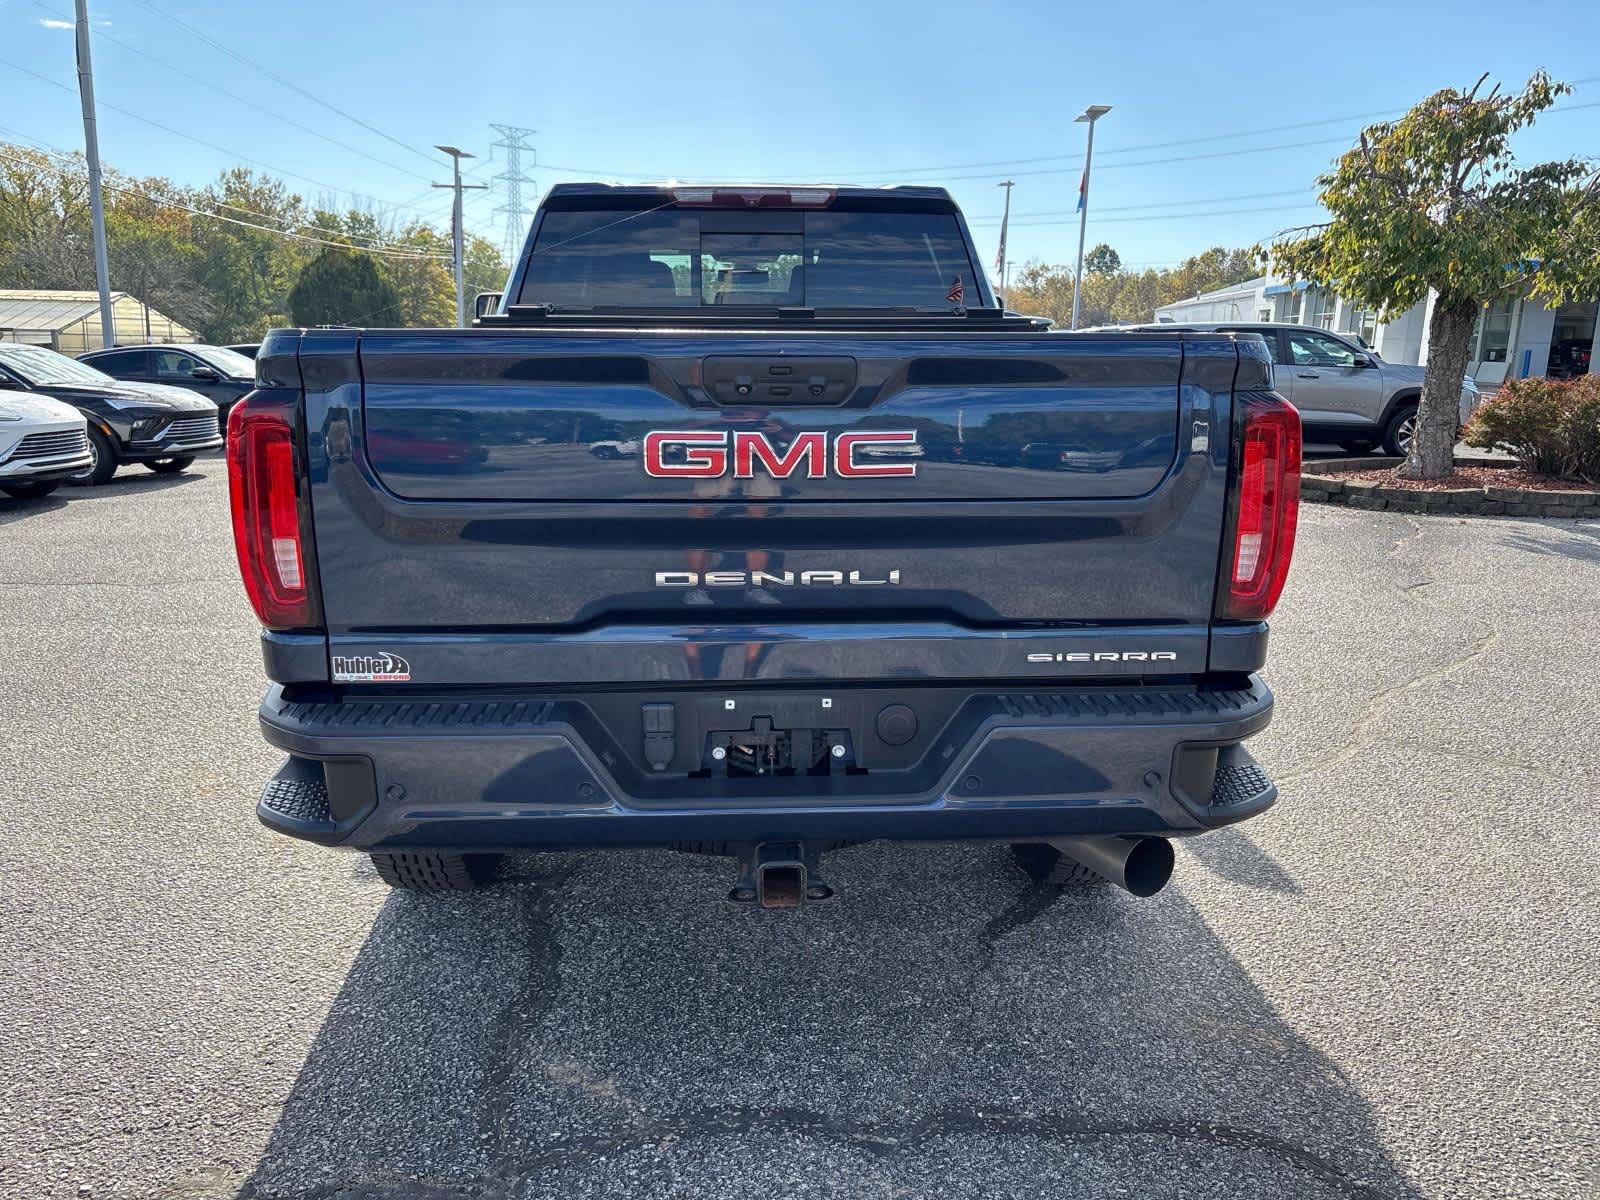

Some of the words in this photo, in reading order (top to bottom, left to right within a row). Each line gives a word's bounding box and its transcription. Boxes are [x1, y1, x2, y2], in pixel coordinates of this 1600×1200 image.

[644, 430, 917, 478] GMC
[655, 570, 900, 587] DENALI
[333, 657, 388, 674] Hubler
[1027, 652, 1177, 662] SIERRA
